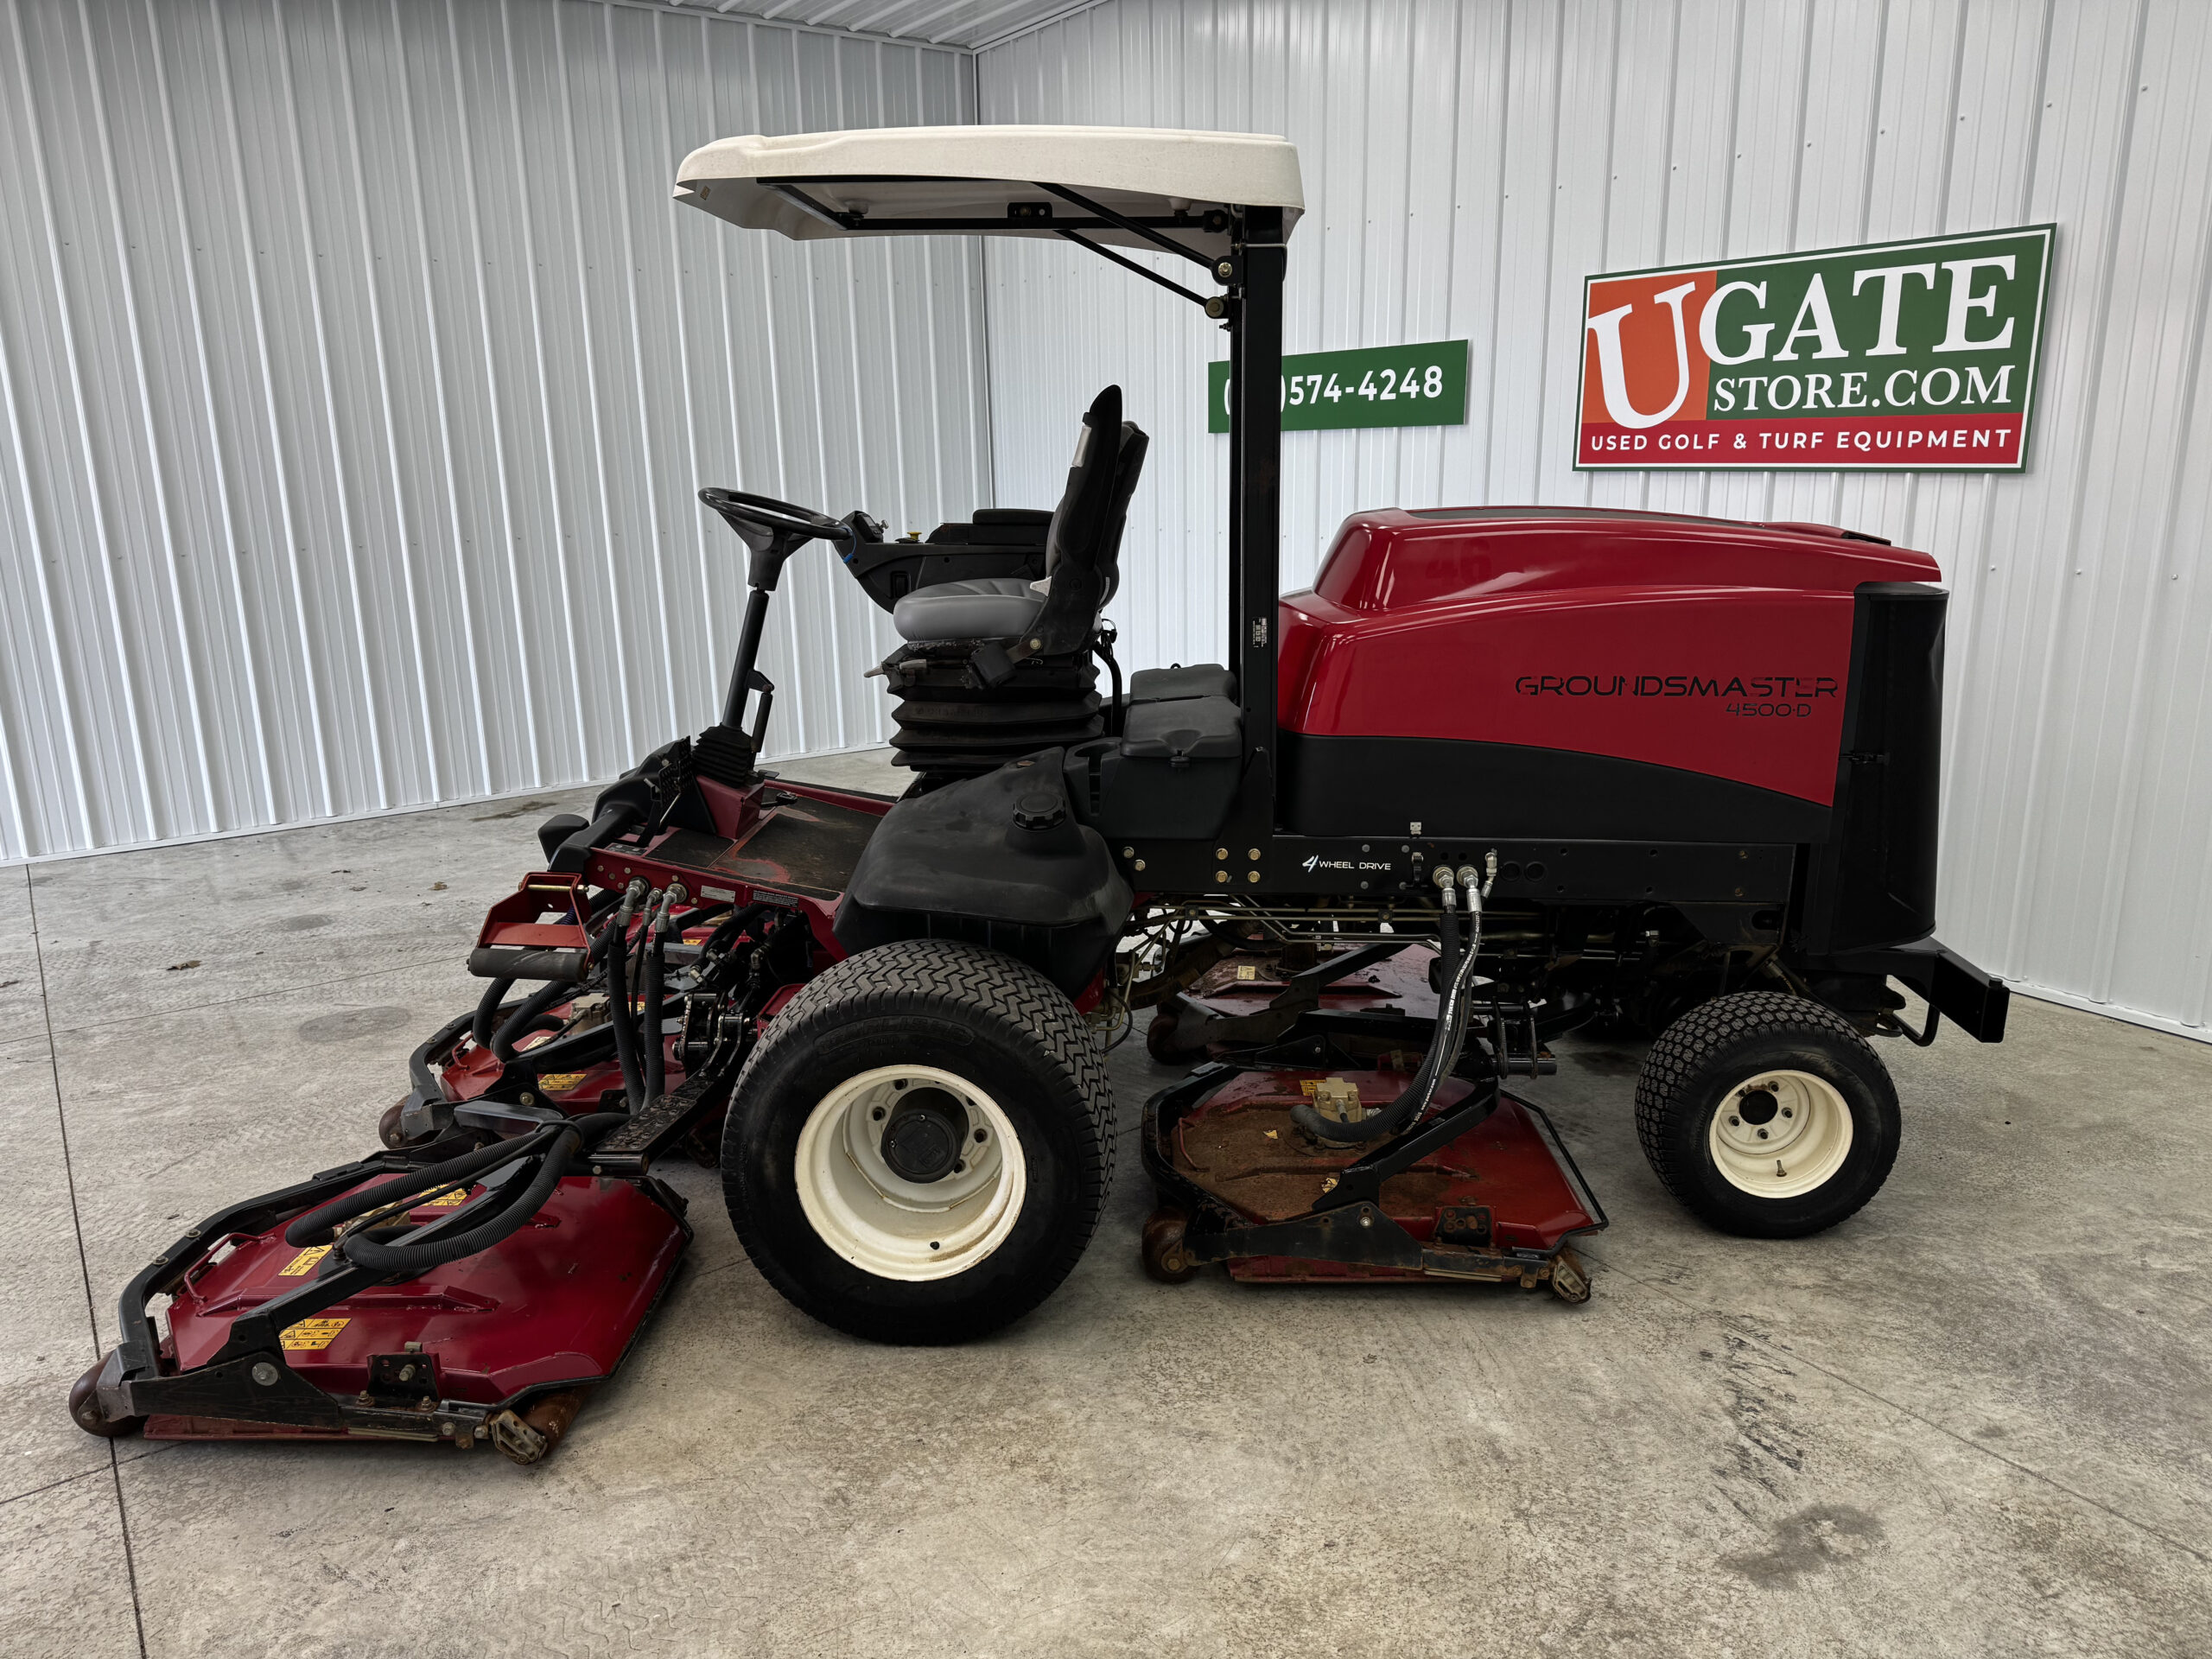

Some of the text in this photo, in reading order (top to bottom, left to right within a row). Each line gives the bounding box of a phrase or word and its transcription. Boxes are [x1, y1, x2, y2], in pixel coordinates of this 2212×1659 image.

[1714, 365, 2016, 412] STORE.COM
[1591, 429, 2012, 452] USED GOLF & TURF EQUIPMENT
[1515, 675, 1839, 697] GROUNDSMASTER
[1302, 855, 1391, 873] 4 WHEEL DRIVE
